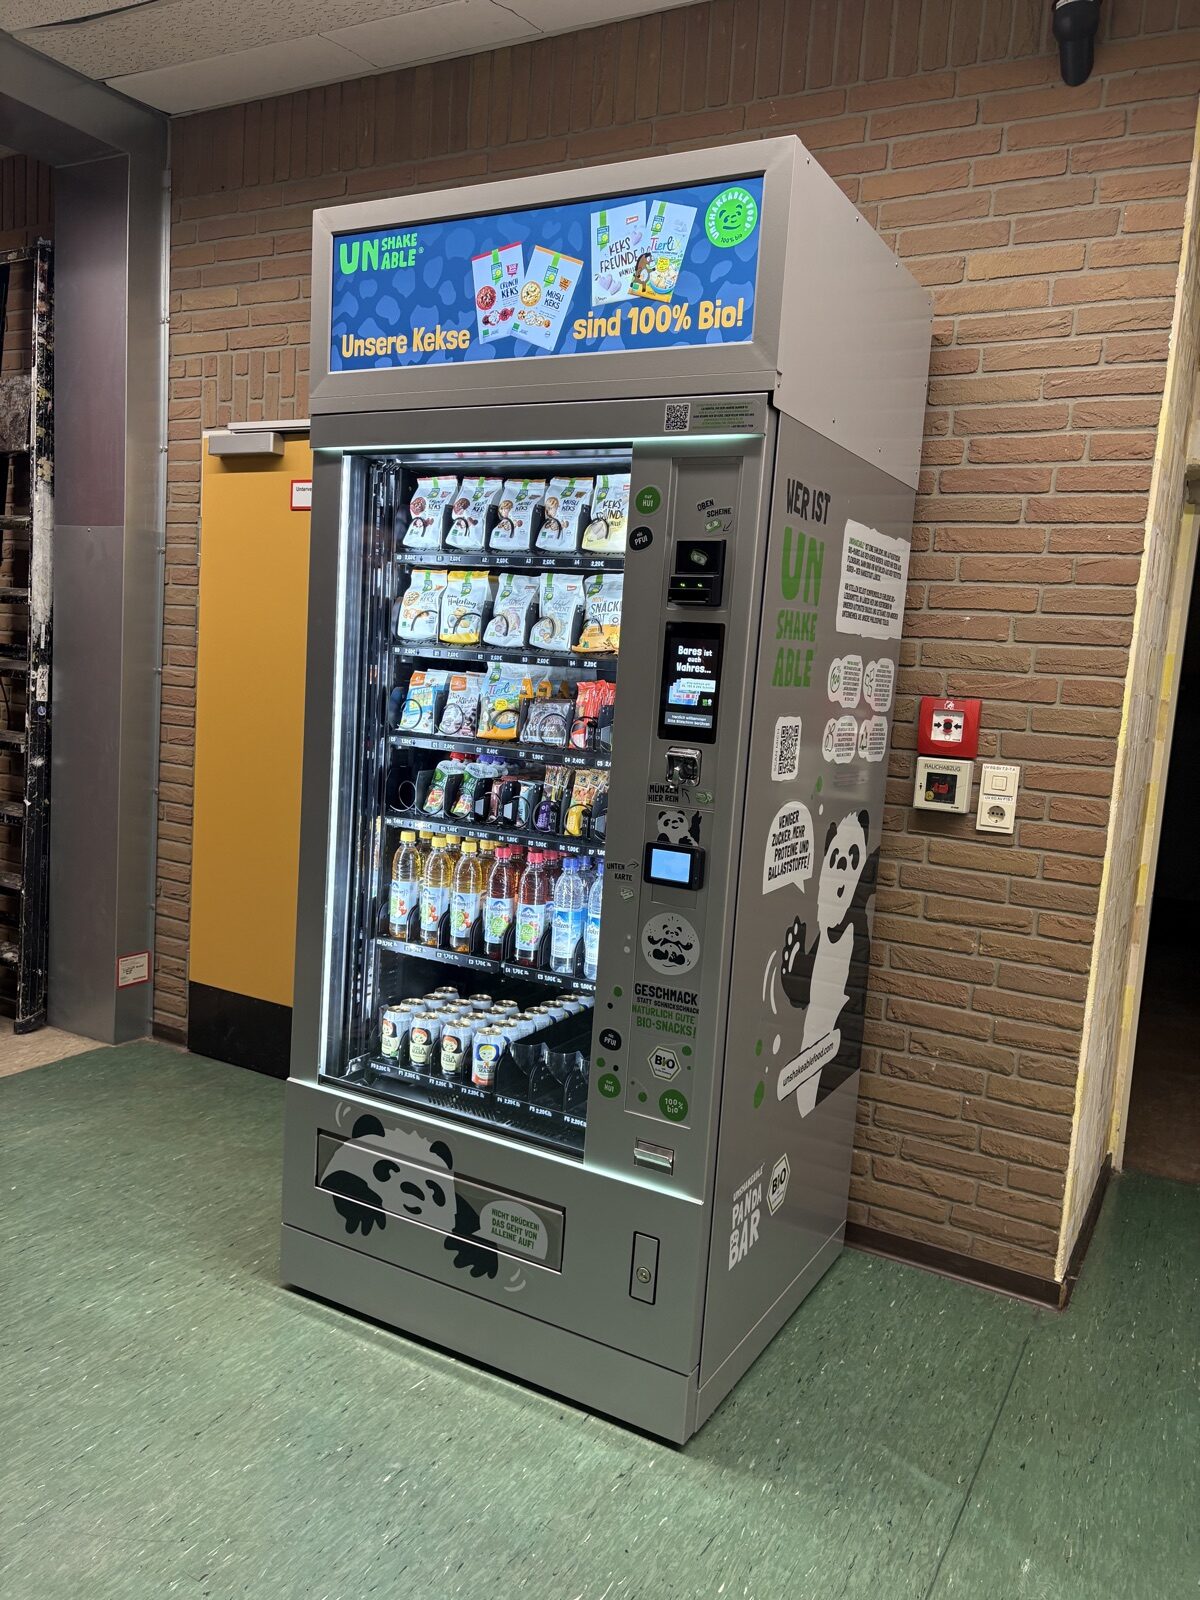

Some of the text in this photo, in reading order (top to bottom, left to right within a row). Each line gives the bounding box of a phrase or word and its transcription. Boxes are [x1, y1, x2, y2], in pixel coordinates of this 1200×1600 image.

[708, 191, 750, 240] UNSHAKEABLE
[381, 233, 418, 251] SHAKE
[608, 236, 631, 255] KEKS
[340, 239, 379, 274] UN
[600, 250, 638, 272] FREUNDE
[502, 286, 518, 298] KEKS
[544, 298, 560, 310] KEKS
[572, 298, 744, 340] sind 100% Bio!
[342, 324, 470, 358] Unsere Kekse
[697, 500, 714, 512] OBEN
[787, 478, 832, 524] WER IST
[706, 508, 732, 518] SCHEINE
[781, 526, 825, 606] UN
[776, 608, 818, 642] SHAKE
[678, 645, 702, 656] Bares
[772, 646, 814, 688] ABLE
[648, 794, 679, 803] HIER REIN
[650, 784, 679, 794] MÜNZEN
[792, 825, 805, 839] MEHR
[774, 840, 809, 862] PROTEINE UND
[607, 862, 625, 870] UNTEN
[614, 873, 633, 881] KARTE
[768, 853, 810, 881] BALLASTSTOFFE!
[634, 983, 698, 1006] GESCHMACK
[636, 997, 700, 1014] STATT SCHNICKSCHNACK
[632, 1004, 695, 1025] NATÜRLICH GUTE
[636, 1016, 697, 1038] BIO-SNACKS!
[732, 1182, 762, 1230] PANDA
[492, 1208, 540, 1231] NICHT DRÜCKEN!
[492, 1218, 538, 1240] DAS GEHT VON
[491, 1228, 534, 1250] ALLEINE AUF!
[728, 1208, 760, 1271] BAR
